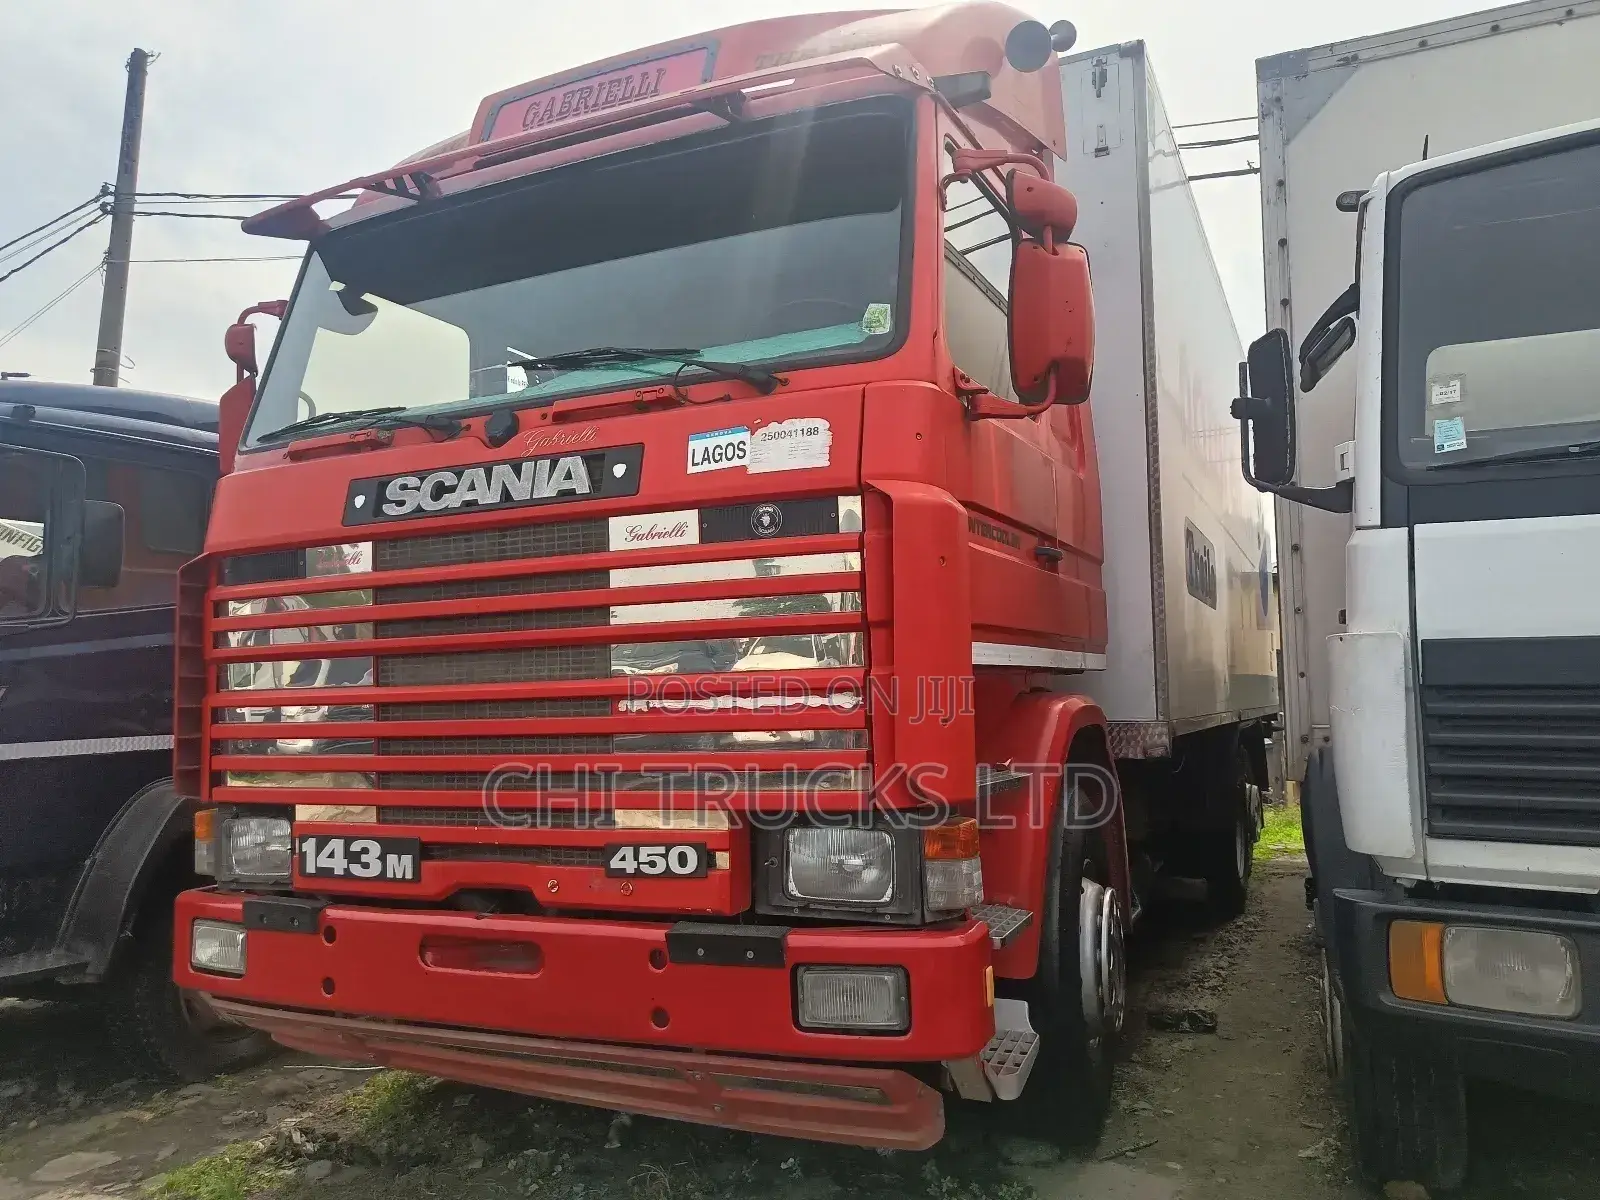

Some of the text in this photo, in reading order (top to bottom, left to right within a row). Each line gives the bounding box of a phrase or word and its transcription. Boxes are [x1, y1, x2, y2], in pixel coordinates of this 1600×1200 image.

[522, 67, 666, 131] GABRIELLI
[520, 425, 600, 458] Gabrielli
[705, 430, 733, 438] GENOVA
[760, 426, 820, 442] 250041188
[691, 440, 747, 467] LAGOS
[382, 455, 591, 516] SCANIA
[624, 521, 689, 543] Gabrielli
[301, 837, 414, 880] 143 M
[609, 845, 698, 875] 450
